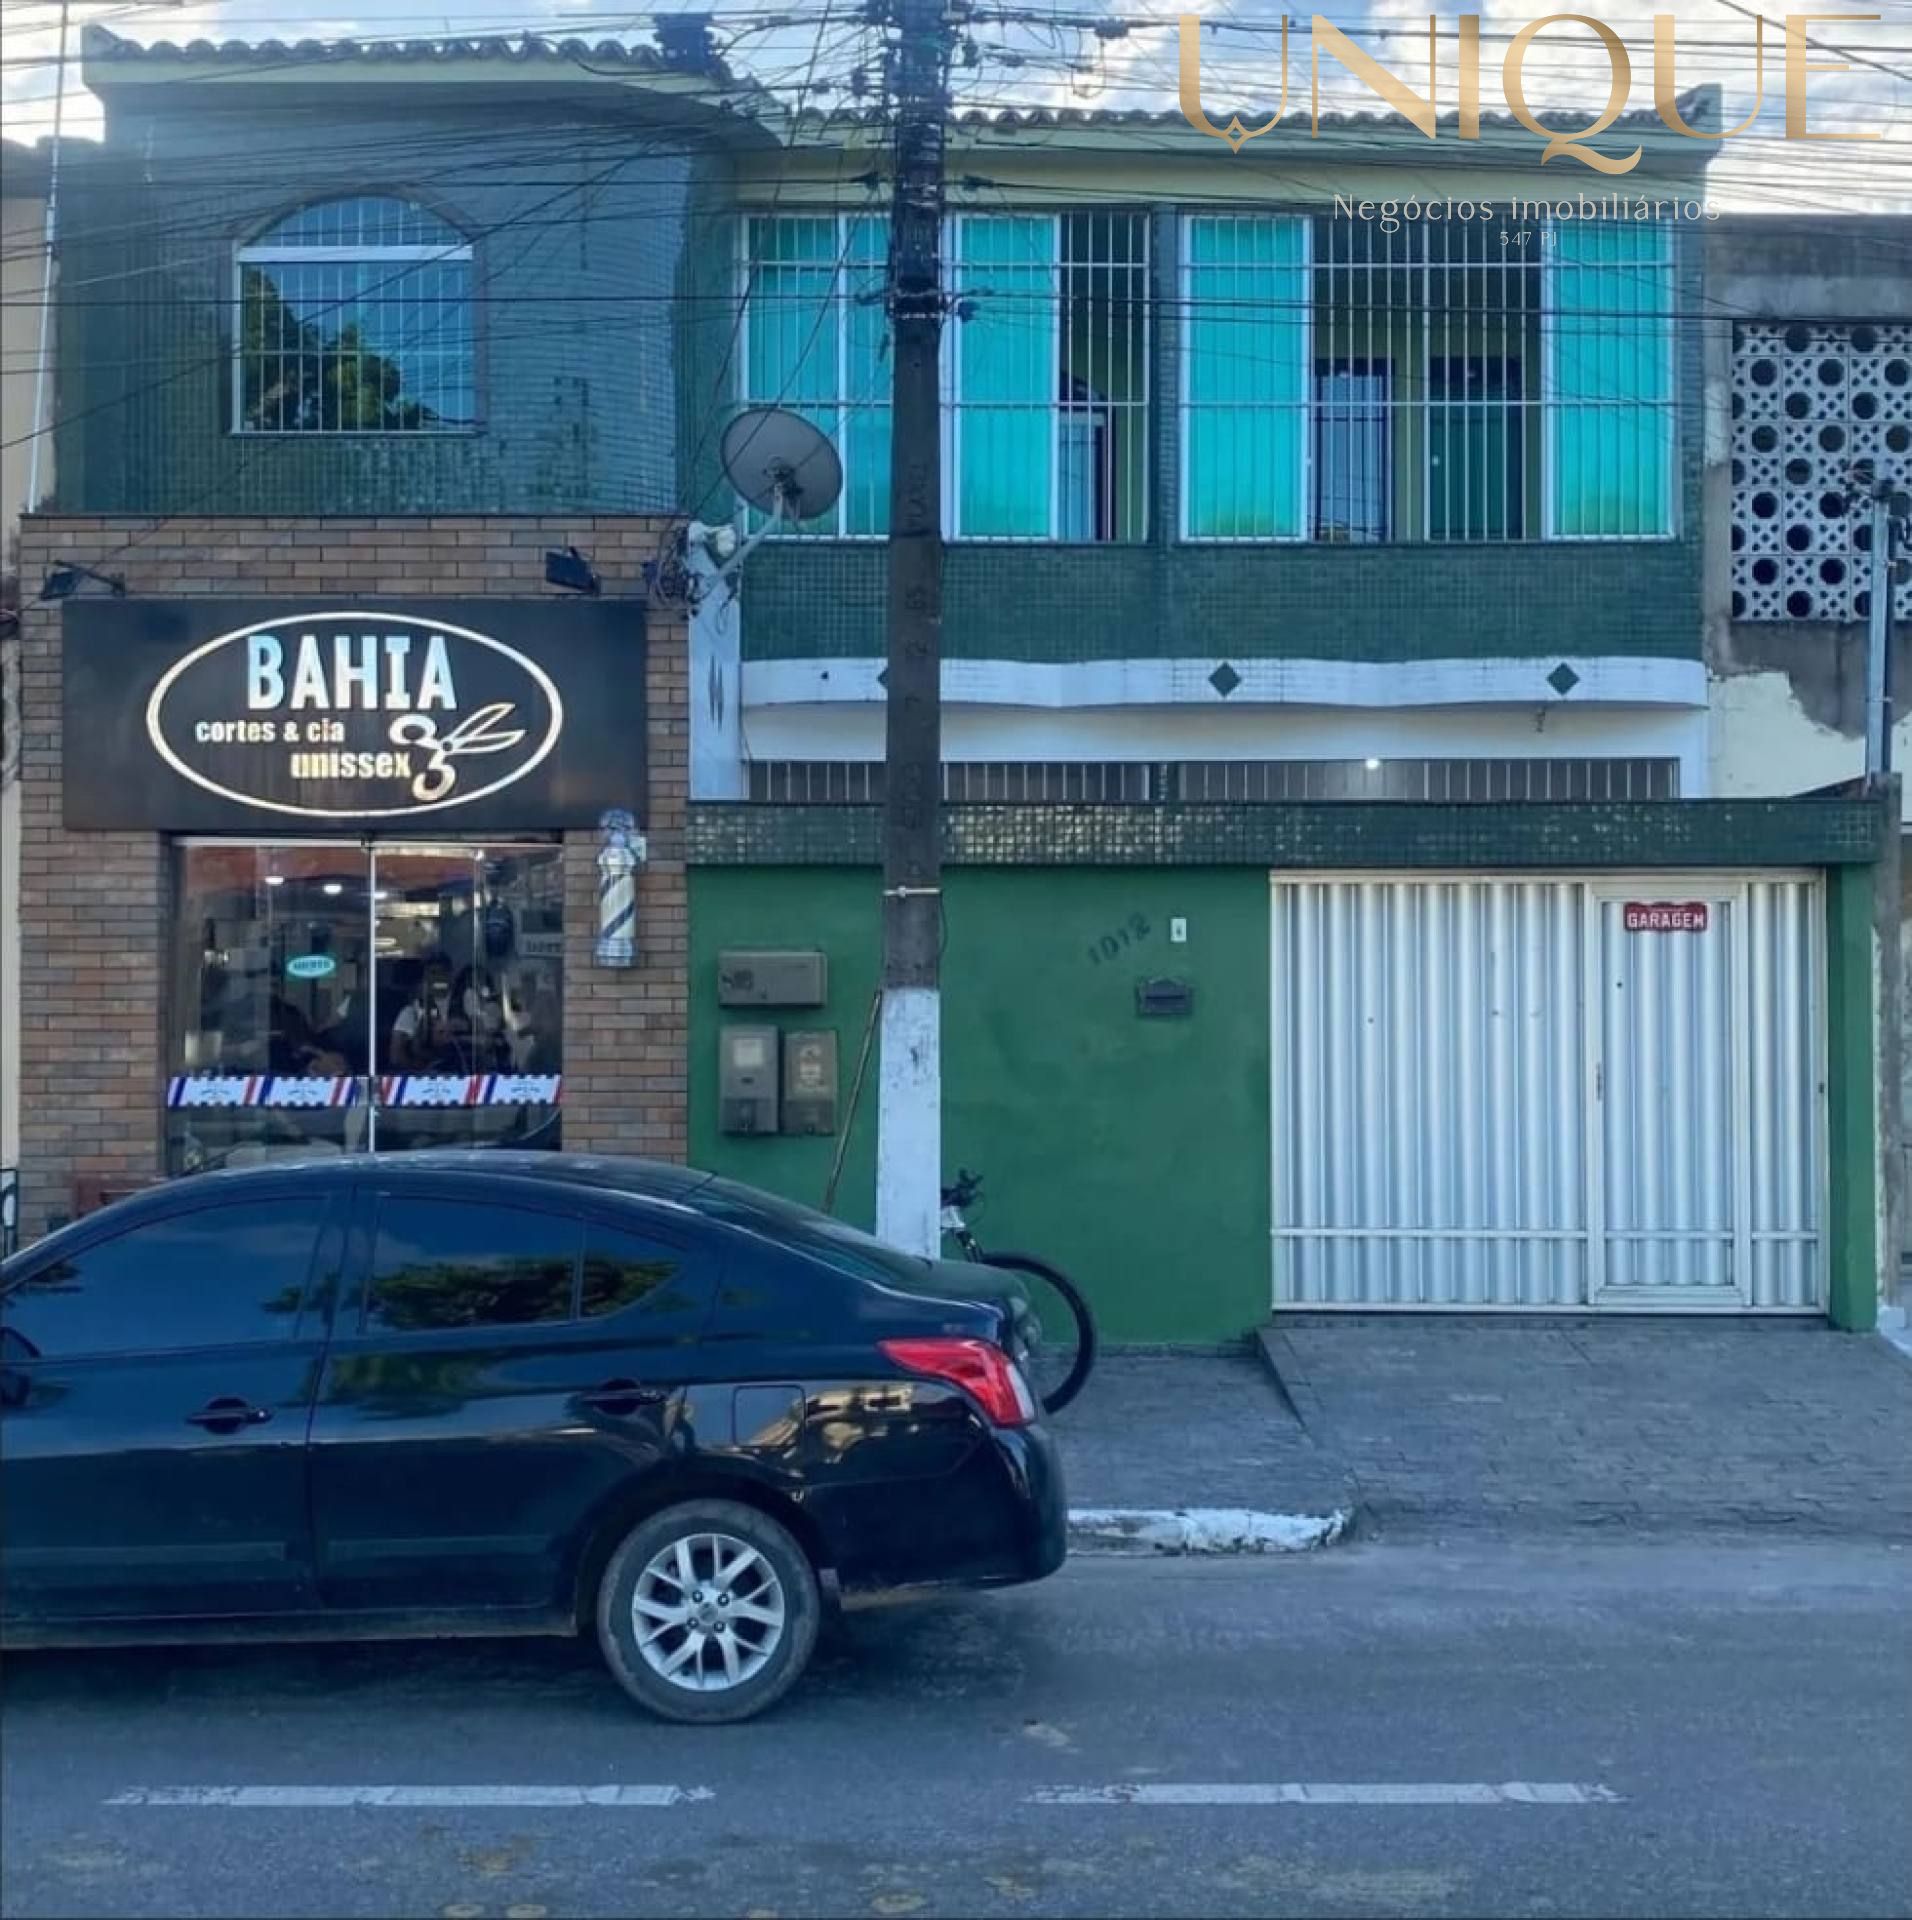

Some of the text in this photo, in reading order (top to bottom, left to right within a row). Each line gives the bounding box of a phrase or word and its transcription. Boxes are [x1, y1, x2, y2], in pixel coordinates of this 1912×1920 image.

[247, 634, 457, 710] BAHIA
[195, 718, 346, 743] cortes & cia
[290, 750, 412, 779] unissex
[1627, 911, 1704, 929] GARAGEM
